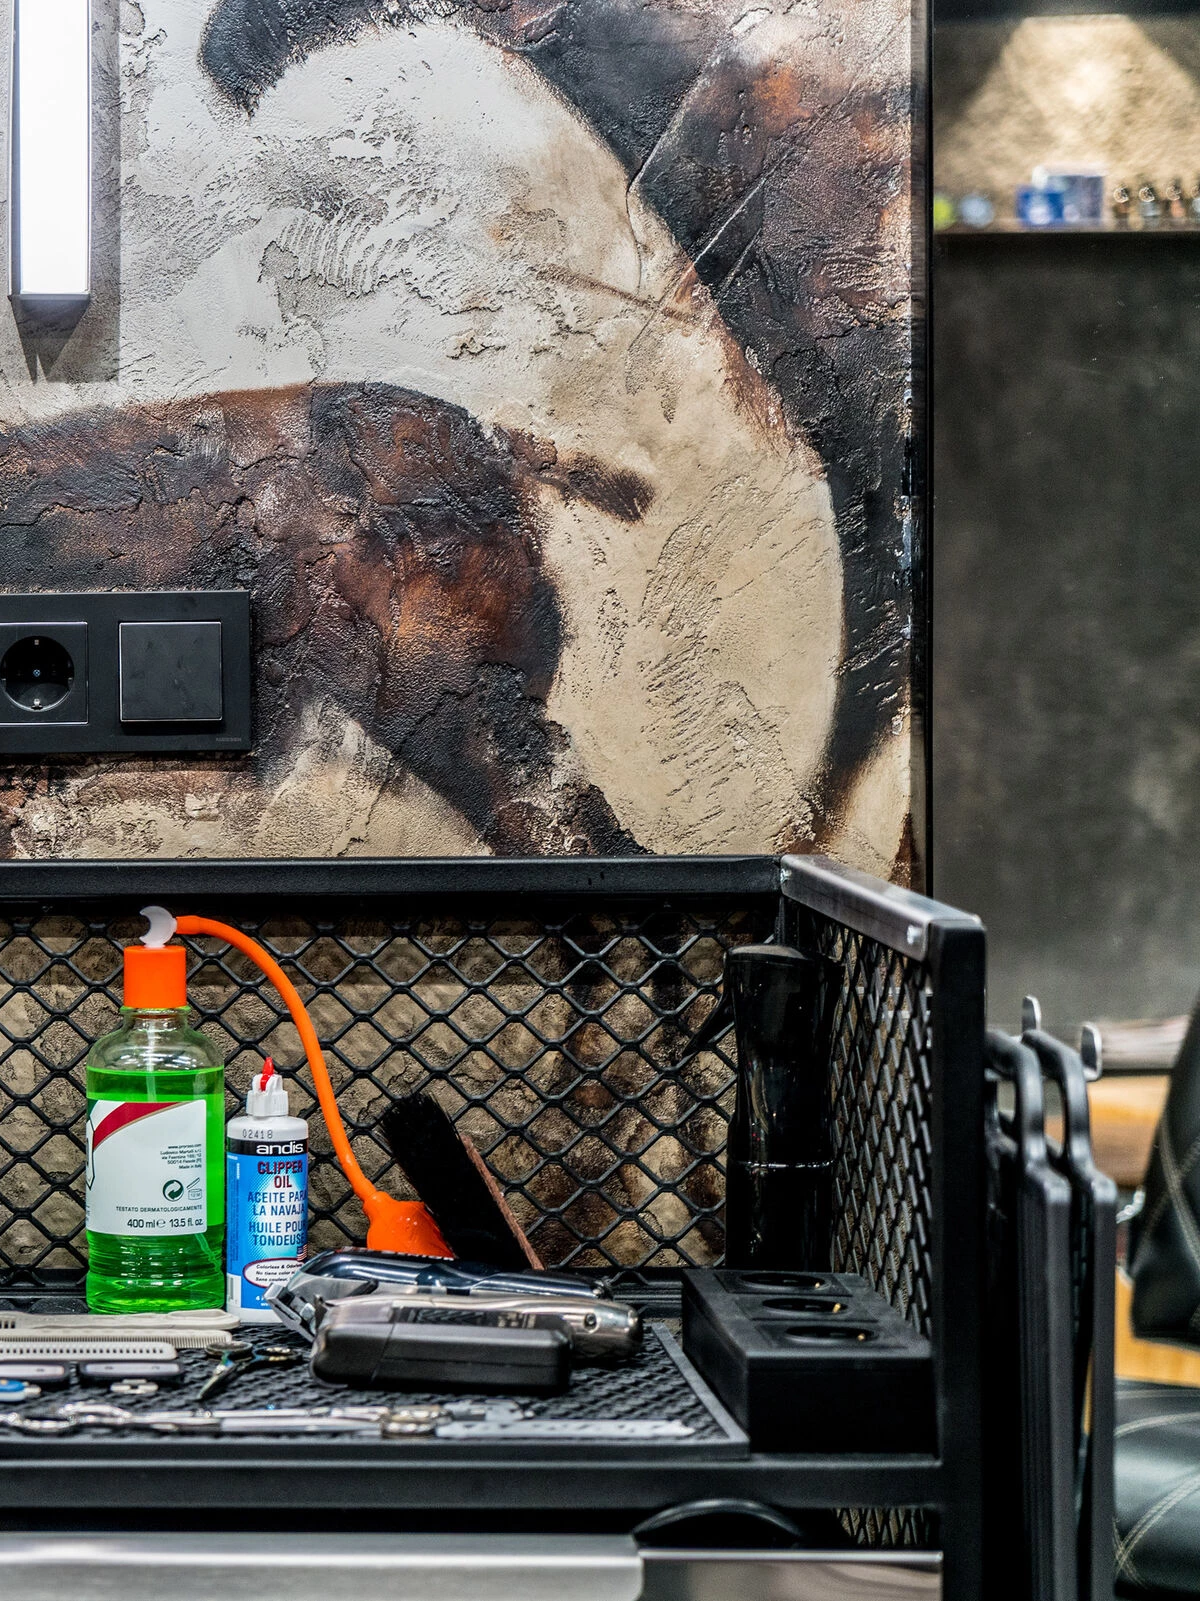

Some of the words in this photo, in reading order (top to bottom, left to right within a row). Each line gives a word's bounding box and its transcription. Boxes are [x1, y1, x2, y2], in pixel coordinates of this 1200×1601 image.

[242, 1129, 273, 1139] 02418
[256, 1141, 304, 1154] andis
[257, 1160, 303, 1174] CLIPPER
[274, 1175, 292, 1188] OIL
[247, 1191, 285, 1203] ACEITE
[140, 1204, 202, 1212] DERMATOLOGICAMENTE
[253, 1204, 266, 1216] LA
[271, 1203, 305, 1216] NAVAJA
[127, 1219, 144, 1228] 400
[169, 1218, 186, 1228] 13.5
[249, 1221, 281, 1233] HUILE
